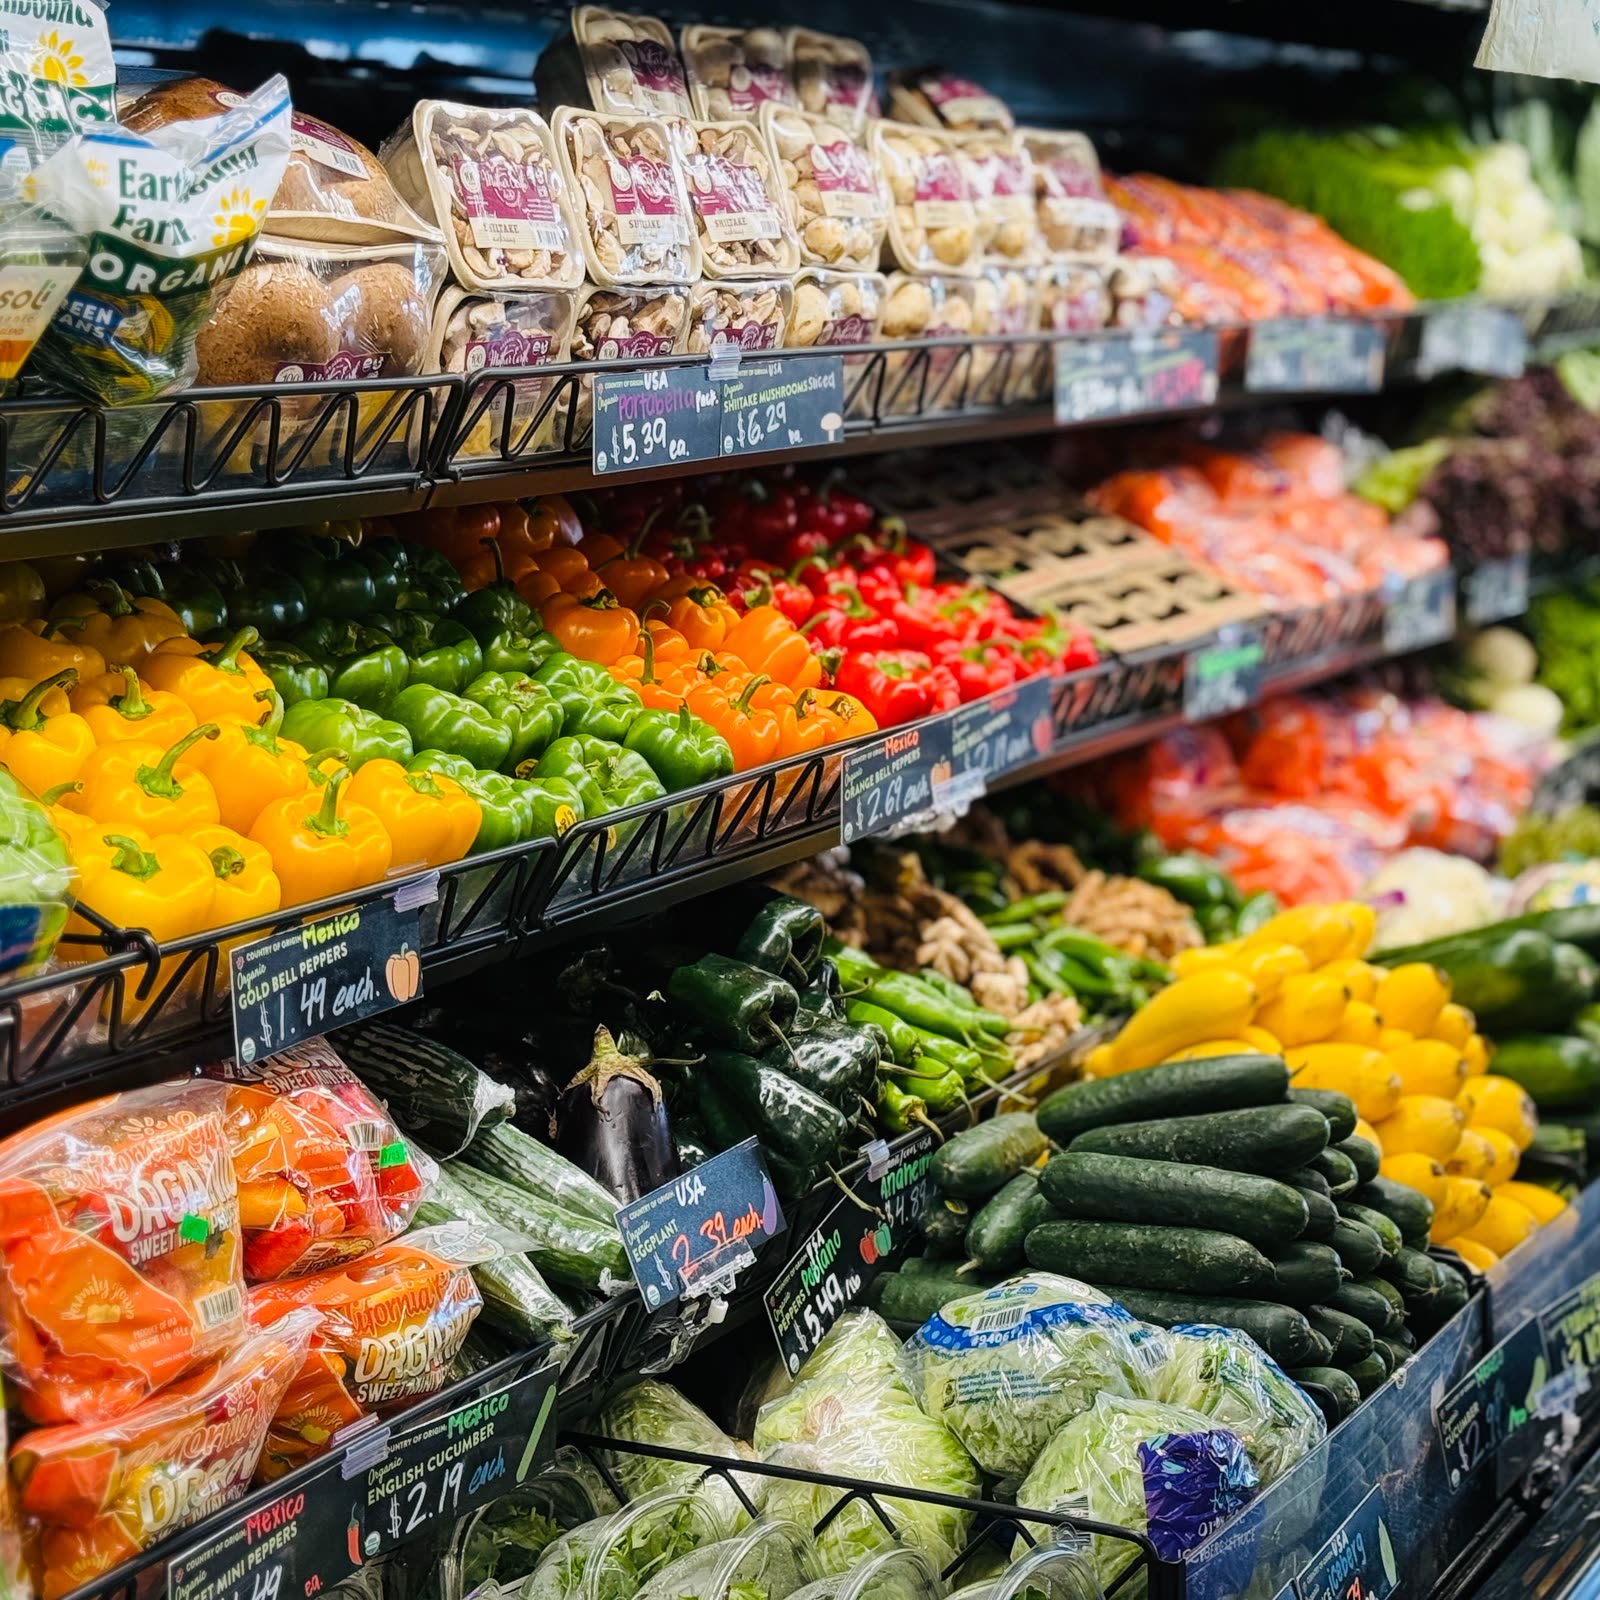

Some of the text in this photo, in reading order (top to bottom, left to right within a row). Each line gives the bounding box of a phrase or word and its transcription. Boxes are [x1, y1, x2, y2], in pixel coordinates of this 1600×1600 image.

[643, 370, 669, 391] USA
[723, 381, 744, 399] Organic
[768, 362, 783, 377] USA
[597, 393, 619, 413] Organic
[723, 393, 758, 413] SHIITAKE
[759, 380, 808, 404] MUSHROOMS
[610, 417, 690, 465] $5.39 ea.
[736, 400, 786, 449] $6.29
[885, 730, 919, 760] Mexico
[844, 747, 921, 801] ORANGE BELL PEPPERS
[856, 775, 903, 831] $2.69
[246, 945, 272, 961] COUNTRY
[272, 941, 281, 953] OF
[302, 912, 360, 949] Mexico
[237, 963, 267, 990] Organic
[239, 941, 348, 1010] GOLD BELL PEPPERS
[259, 965, 380, 1048] $1.49 each.
[629, 1202, 651, 1220] COUNTRY
[650, 1199, 657, 1209] OF
[675, 1175, 707, 1207] USA
[880, 1151, 934, 1200] Anaheim
[130, 1232, 177, 1265] SWEET
[626, 1219, 651, 1246] Organic
[631, 1218, 679, 1263] EGGPLANT
[774, 1273, 791, 1296] COUNTRY
[806, 1228, 825, 1262] USA
[777, 1228, 841, 1337] PEPPERS Poblano
[793, 1272, 844, 1353] $5.49
[356, 1380, 404, 1404] SWEET
[412, 1433, 423, 1444] OF
[447, 1393, 510, 1440] Mexico
[1443, 1401, 1481, 1450] CUCUMBER
[367, 1421, 495, 1507] ENGLISH CUCUMBER
[367, 1456, 404, 1486] Organic
[386, 1461, 465, 1539] $2.19
[186, 1550, 214, 1572] COUNTRY
[214, 1541, 224, 1554] OF
[246, 1493, 305, 1545] Mexico
[1330, 1529, 1350, 1557] USA
[216, 1560, 245, 1594] MINI
[247, 1520, 298, 1571] PEPPERS
[174, 1570, 208, 1600] Organic
[304, 1574, 324, 1598] ea.
